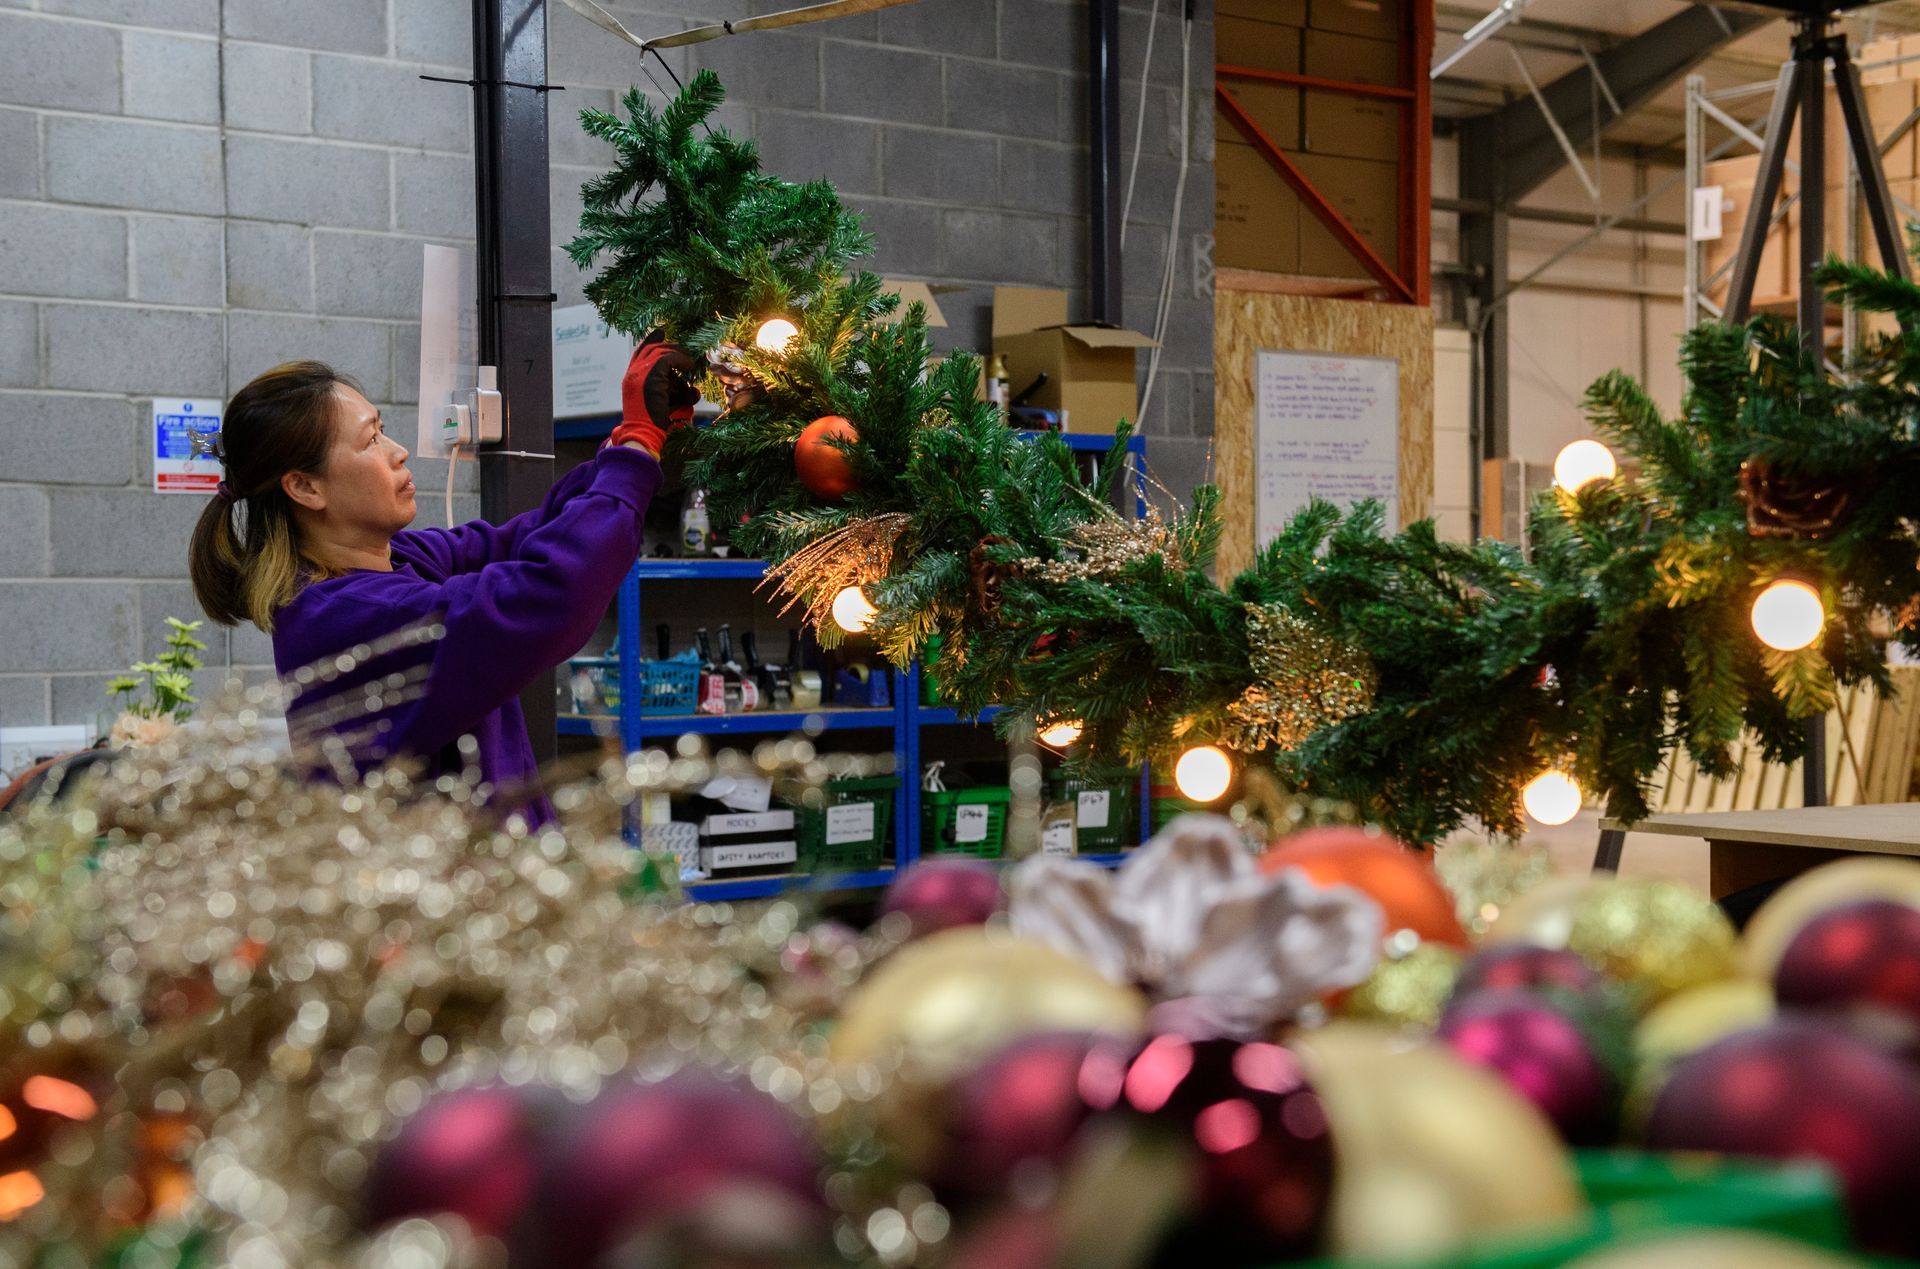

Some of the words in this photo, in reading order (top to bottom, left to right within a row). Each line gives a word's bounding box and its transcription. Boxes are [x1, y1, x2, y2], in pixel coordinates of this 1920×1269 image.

[523, 359, 534, 375] 7
[158, 415, 181, 426] Fire
[183, 416, 219, 427] action
